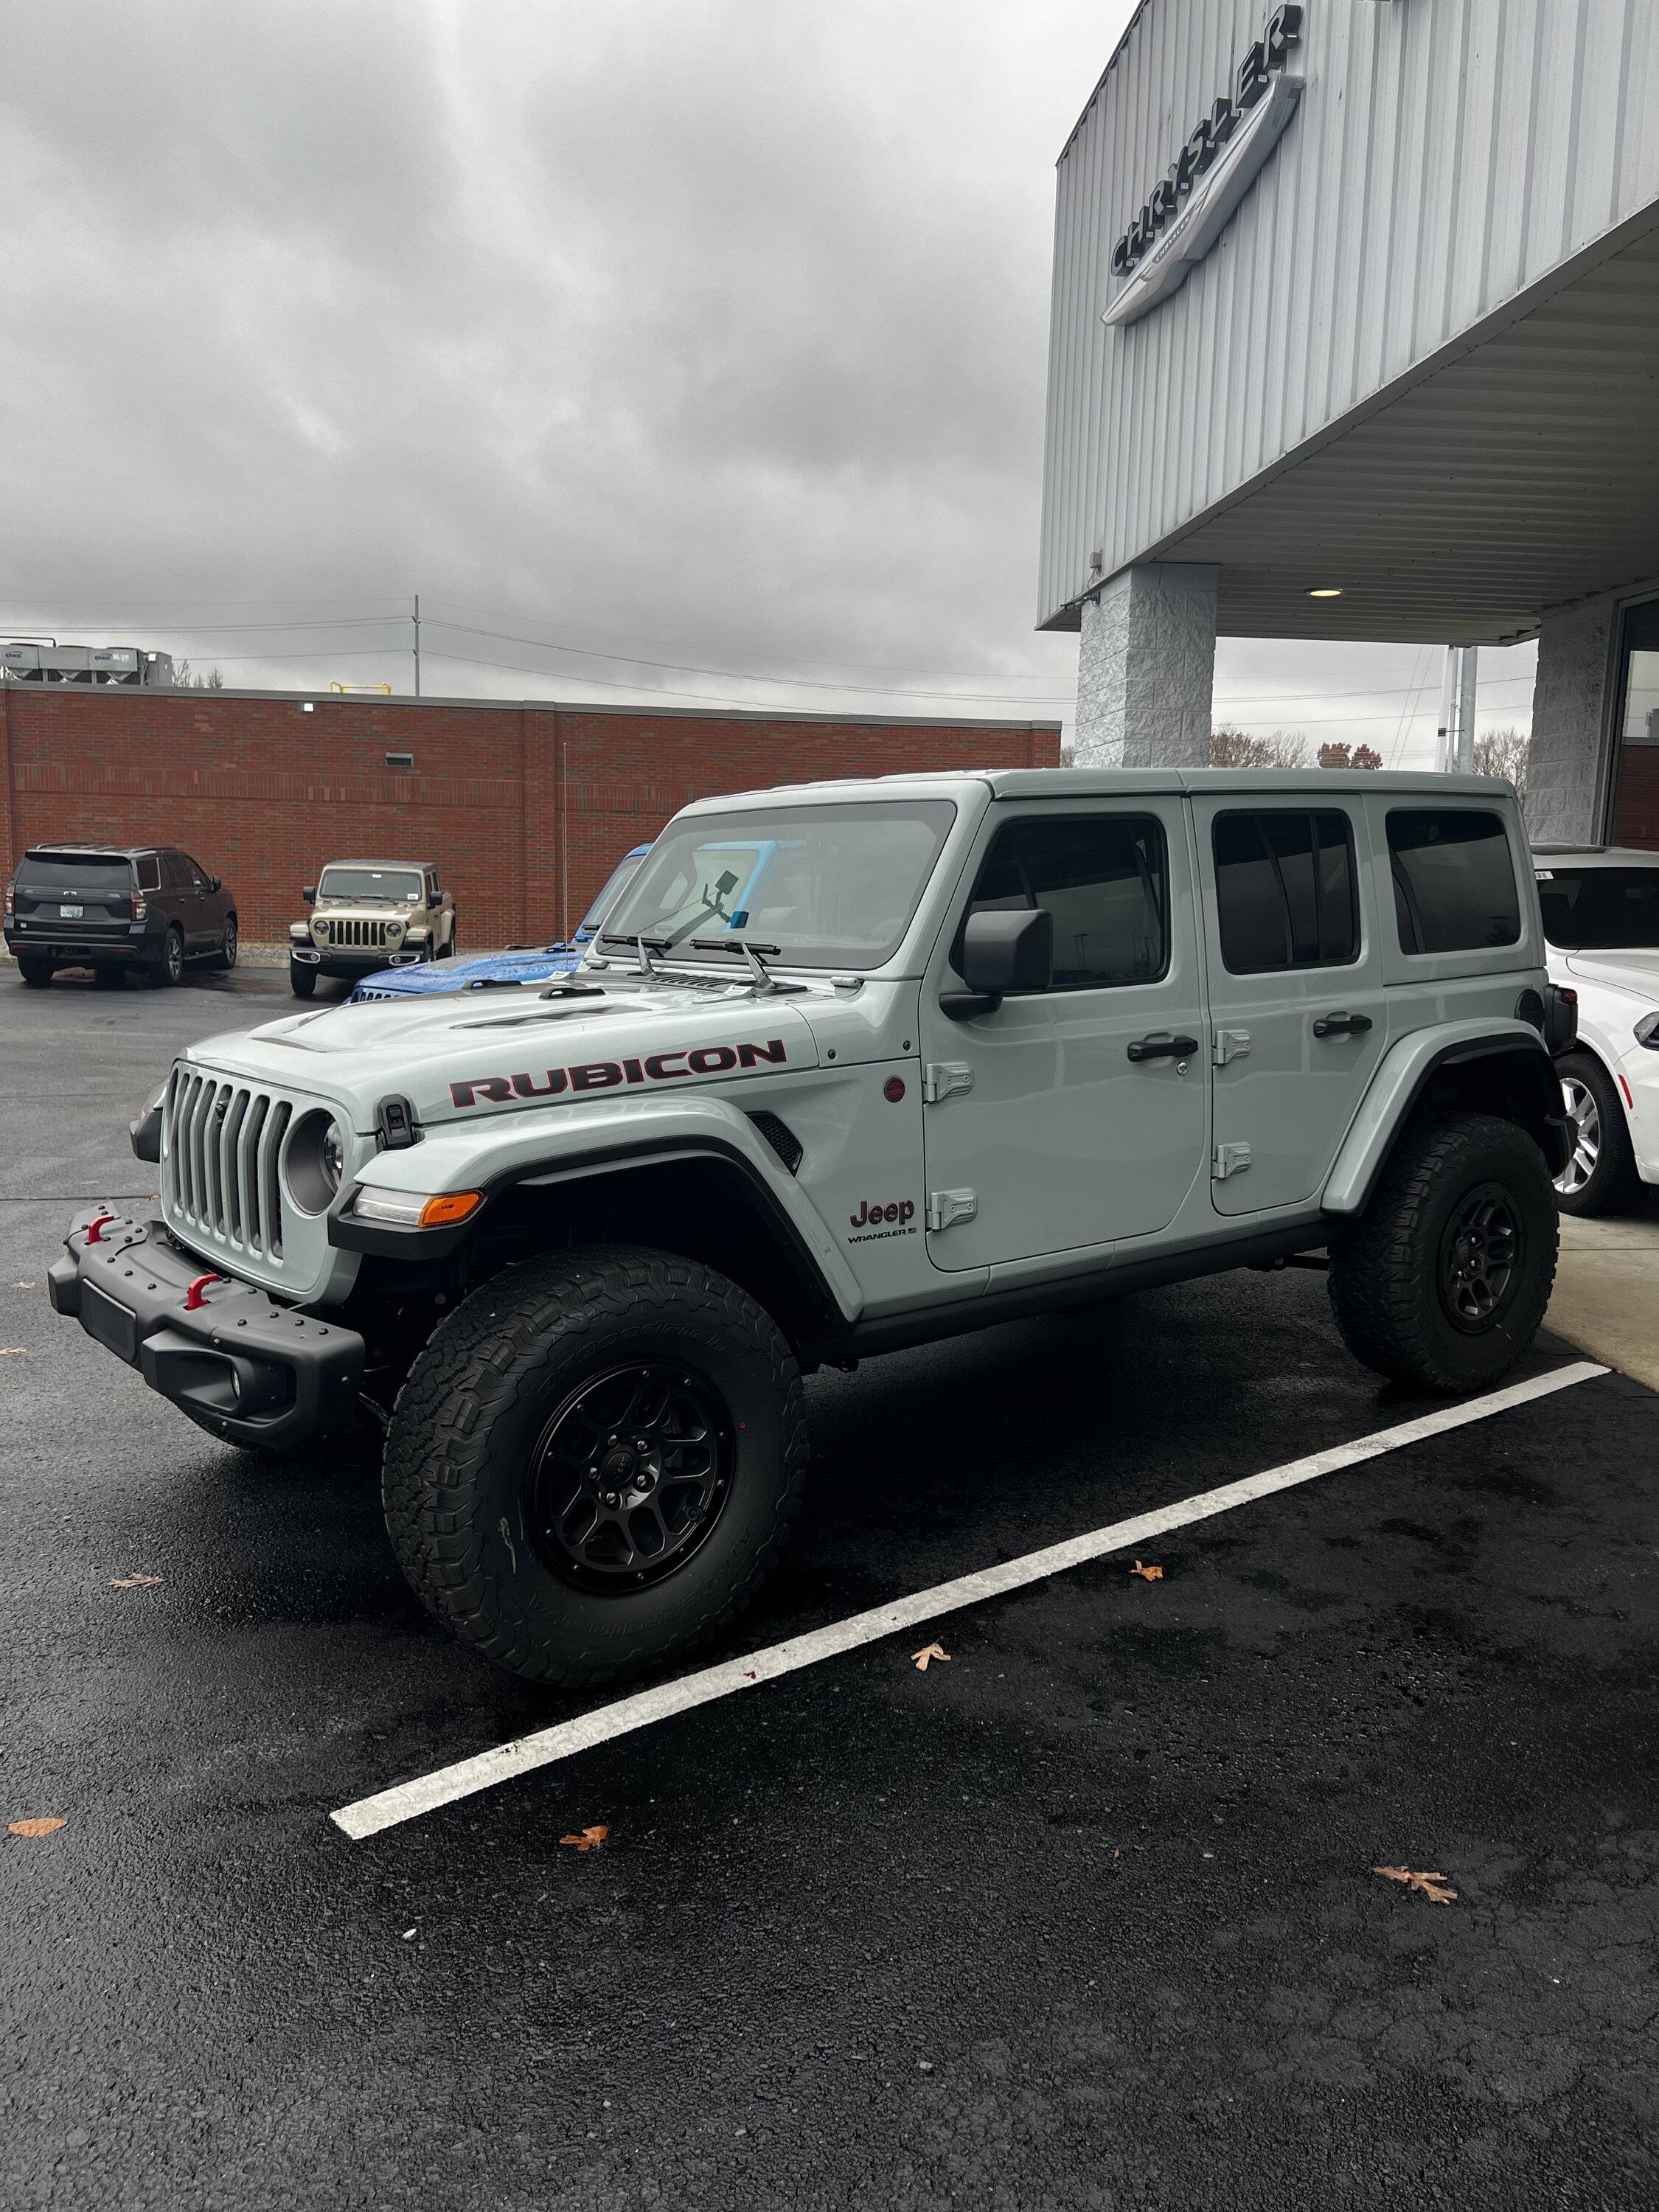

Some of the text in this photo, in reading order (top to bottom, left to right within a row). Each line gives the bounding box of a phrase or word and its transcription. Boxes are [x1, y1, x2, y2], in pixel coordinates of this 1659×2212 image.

[1111, 4, 1302, 276] CHRYSLER
[449, 1039, 787, 1107] RUBICON
[847, 1228, 906, 1244] WRANGLER
[850, 1200, 914, 1228] Jeep
